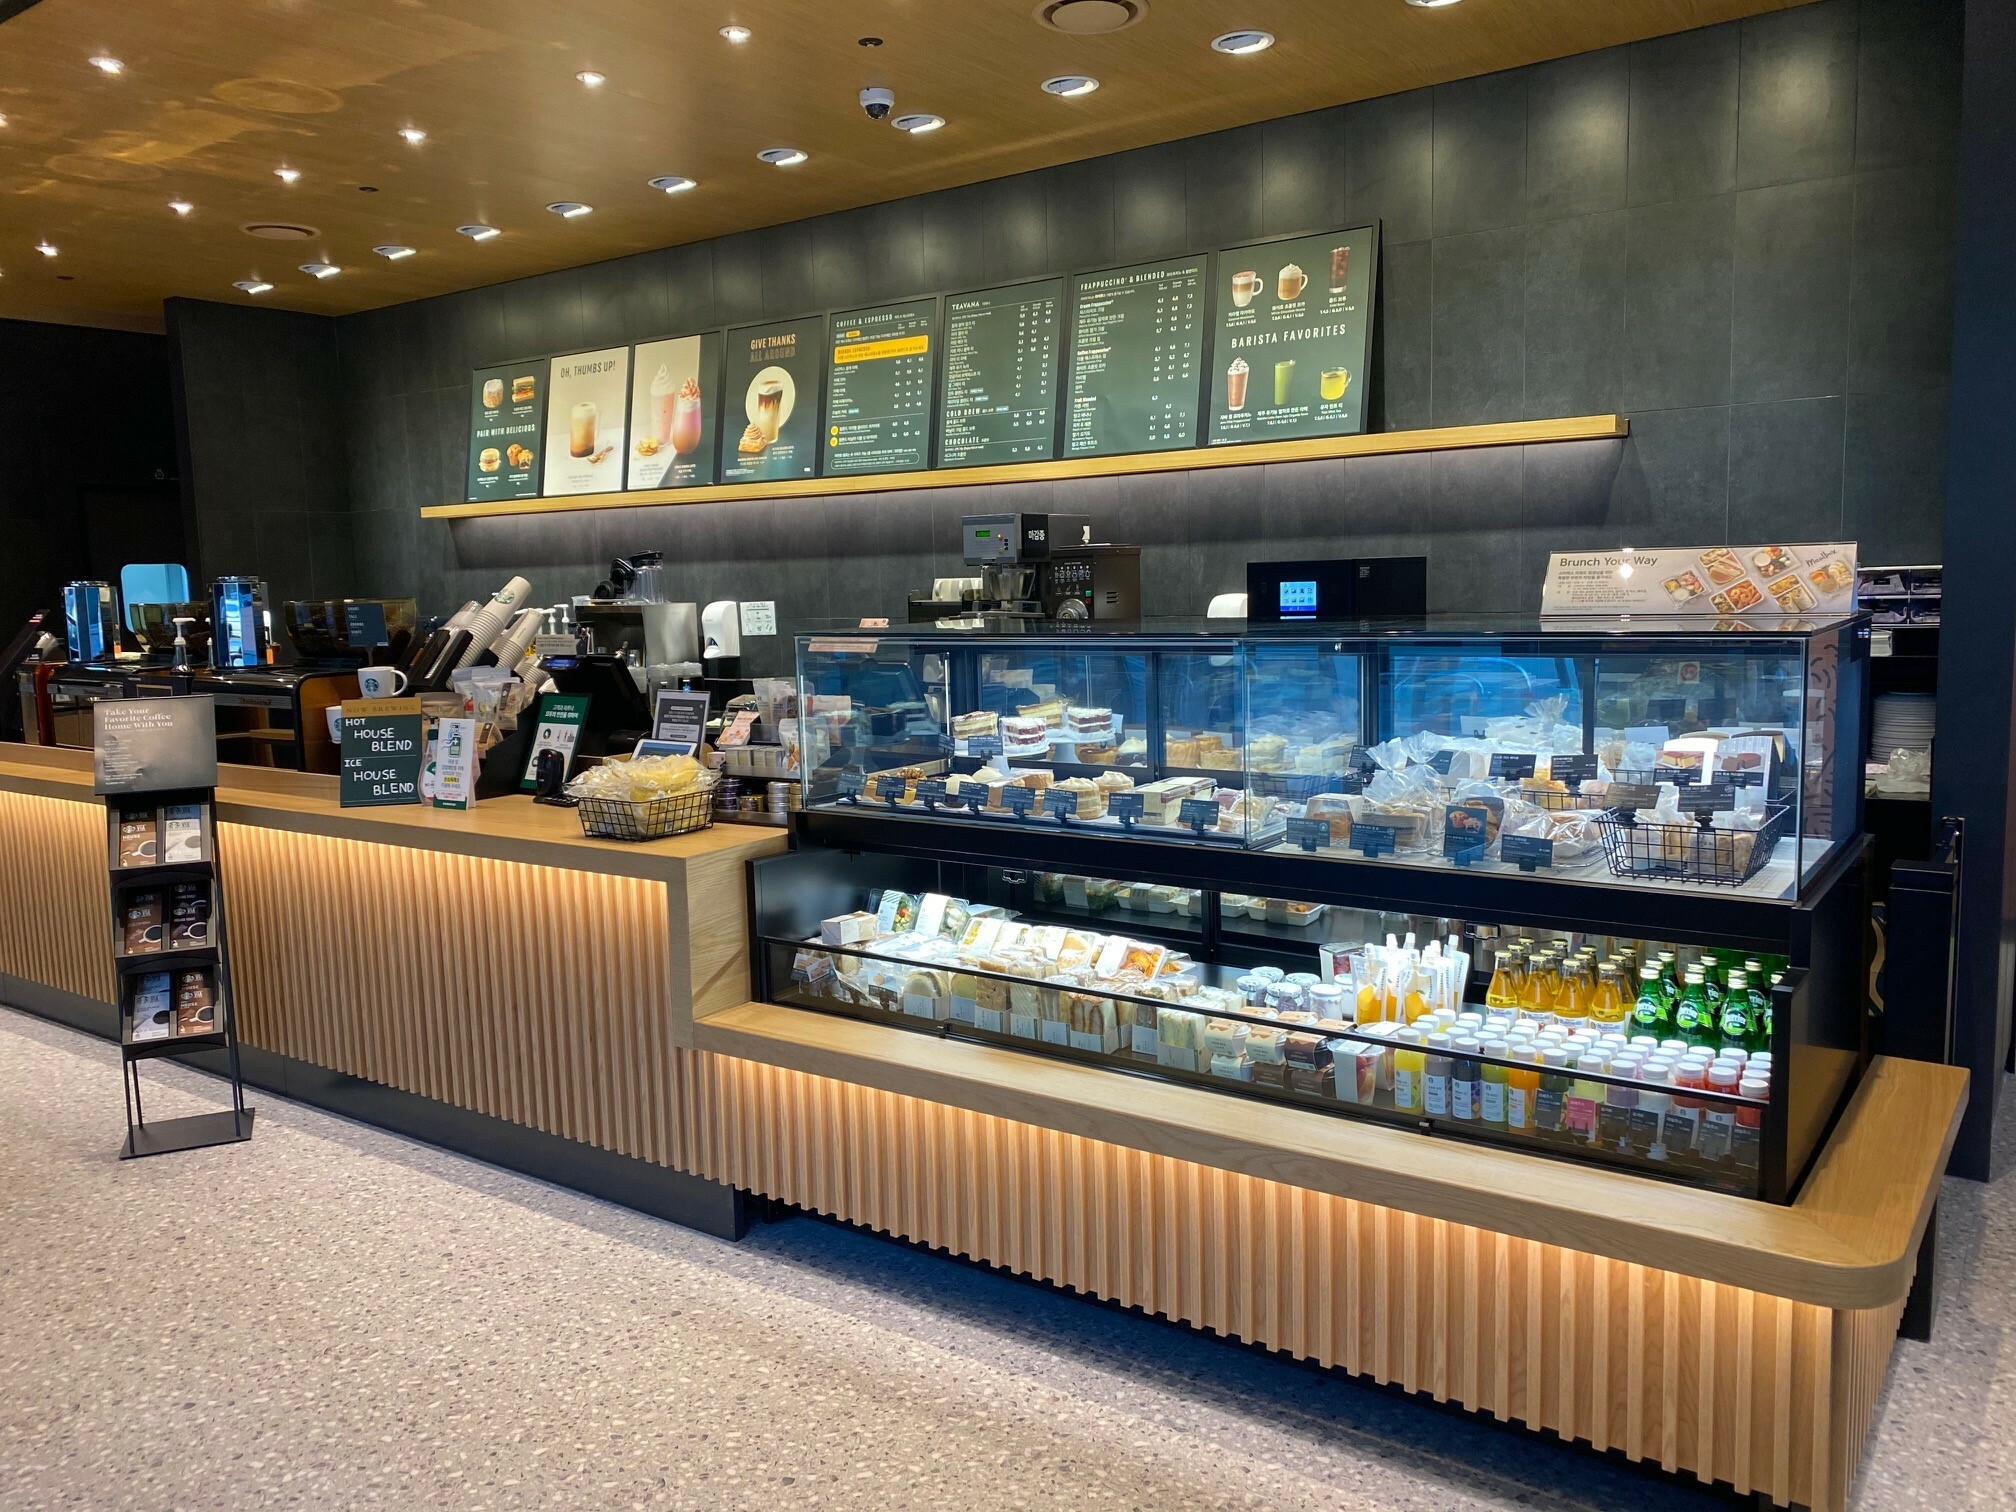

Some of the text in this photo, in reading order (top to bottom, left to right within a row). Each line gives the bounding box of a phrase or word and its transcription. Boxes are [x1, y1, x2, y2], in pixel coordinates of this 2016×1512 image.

[1136, 270, 1164, 282] BLENDED
[952, 301, 980, 310] TEAVANA
[836, 318, 856, 328] COFFEE
[864, 314, 892, 324] ESPRESSO
[750, 334, 796, 350] GIVE THANKS
[1232, 324, 1346, 348] BARISTA FAVORITES
[560, 360, 616, 378] OH, THUMBS UP!
[476, 424, 536, 438] PAIR WITH DELICIOUS
[944, 436, 980, 446] CHOCOLATE
[1560, 556, 1658, 567] Brunch Your Way
[345, 718, 366, 726] HOT
[354, 728, 394, 740] HOUSE
[371, 740, 412, 752] BLEND
[344, 759, 362, 768] ICE
[354, 769, 396, 782] HOUSE
[373, 782, 414, 796] BLEND
